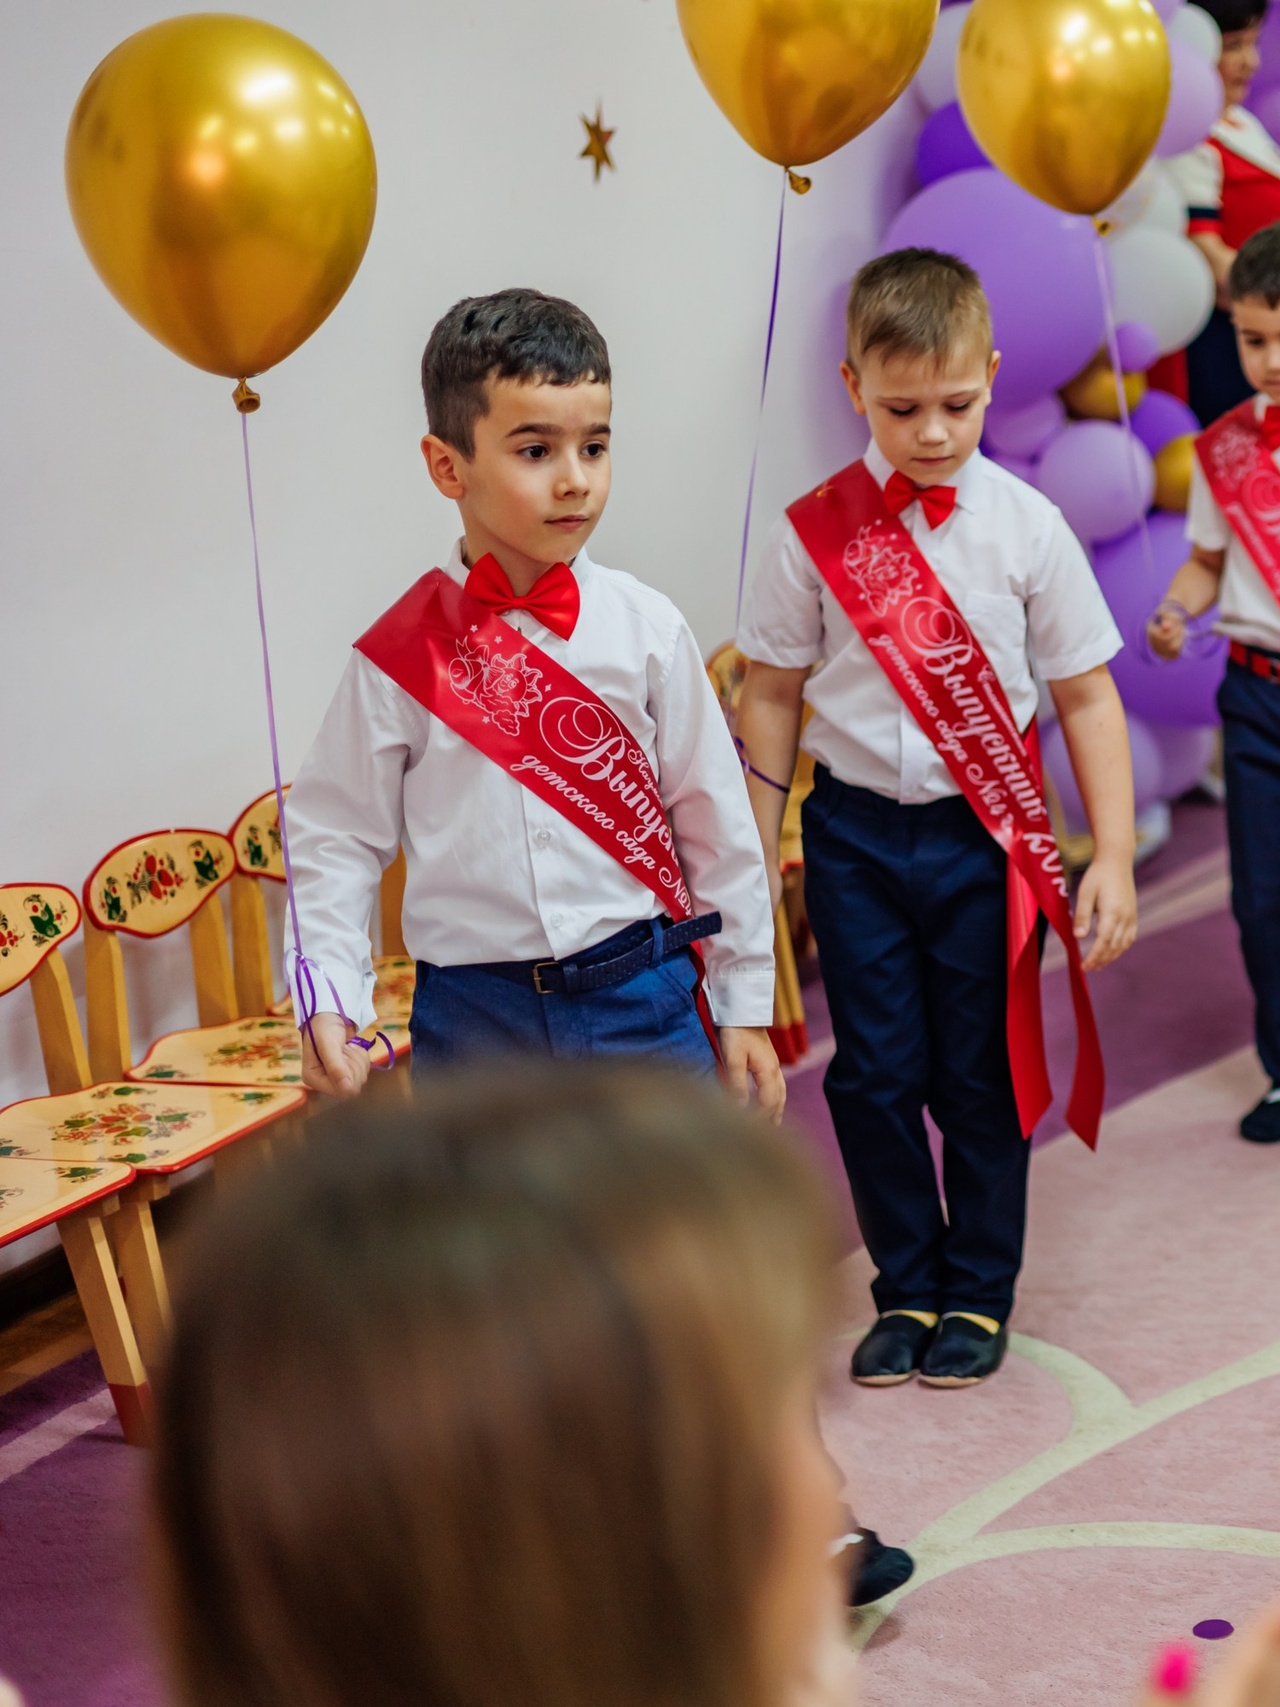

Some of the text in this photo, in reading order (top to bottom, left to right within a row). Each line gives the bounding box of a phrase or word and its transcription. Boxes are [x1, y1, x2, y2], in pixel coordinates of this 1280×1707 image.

[868, 633, 939, 719] детского
[935, 716, 968, 765] сада
[901, 597, 1048, 822] Выпускник
[510, 754, 615, 831] детского
[616, 829, 655, 870] сада
